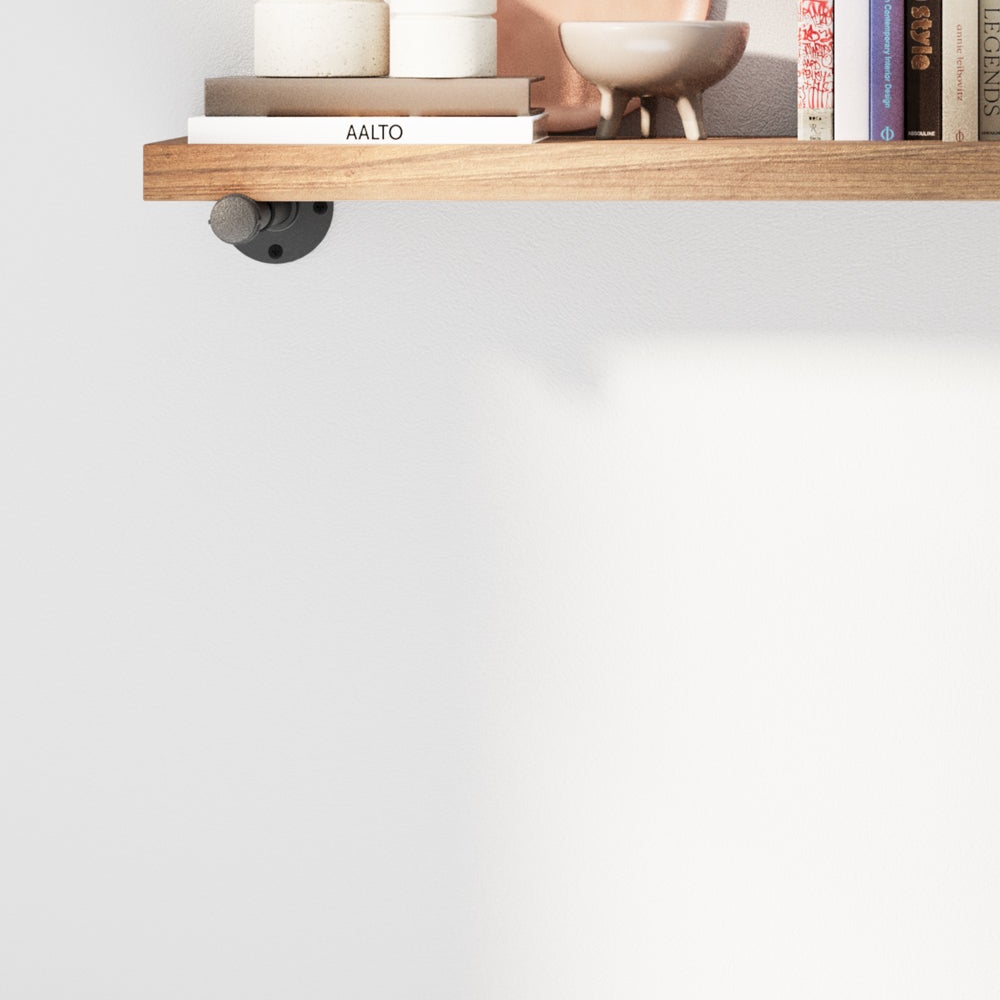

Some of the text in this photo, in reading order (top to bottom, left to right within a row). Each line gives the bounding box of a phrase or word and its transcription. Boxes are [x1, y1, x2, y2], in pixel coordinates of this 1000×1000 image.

[882, 4, 892, 55] Contemporary
[909, 5, 933, 71] style
[884, 56, 892, 82] Interior
[957, 56, 965, 102] leibovitz
[984, 8, 1000, 118] LEGENDS
[882, 83, 892, 109] Design
[346, 124, 404, 141] AALTO
